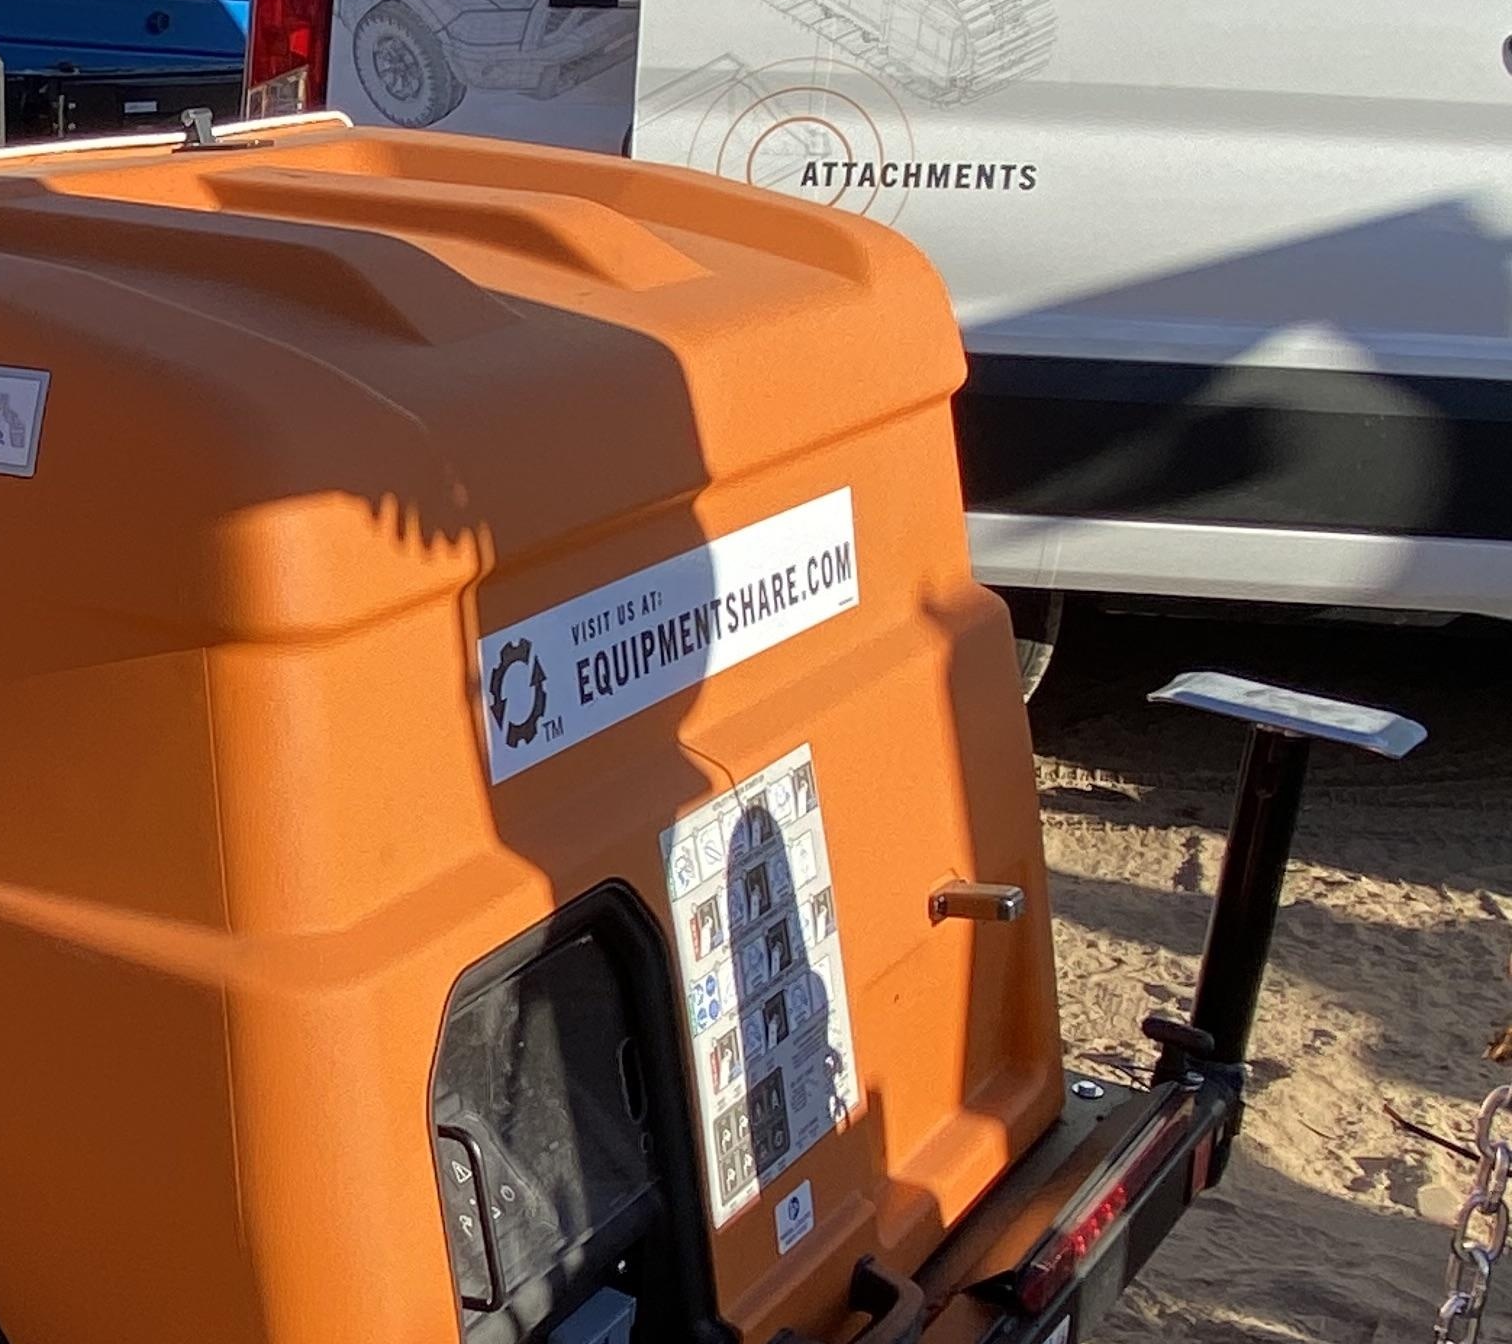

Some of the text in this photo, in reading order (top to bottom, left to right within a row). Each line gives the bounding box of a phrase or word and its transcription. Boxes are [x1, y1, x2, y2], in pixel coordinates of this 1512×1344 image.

[800, 162, 1038, 191] ATTACHMENTS
[571, 591, 663, 646] VISIT US AT:
[576, 541, 853, 706] EQUIPMENTSHARE.COM
